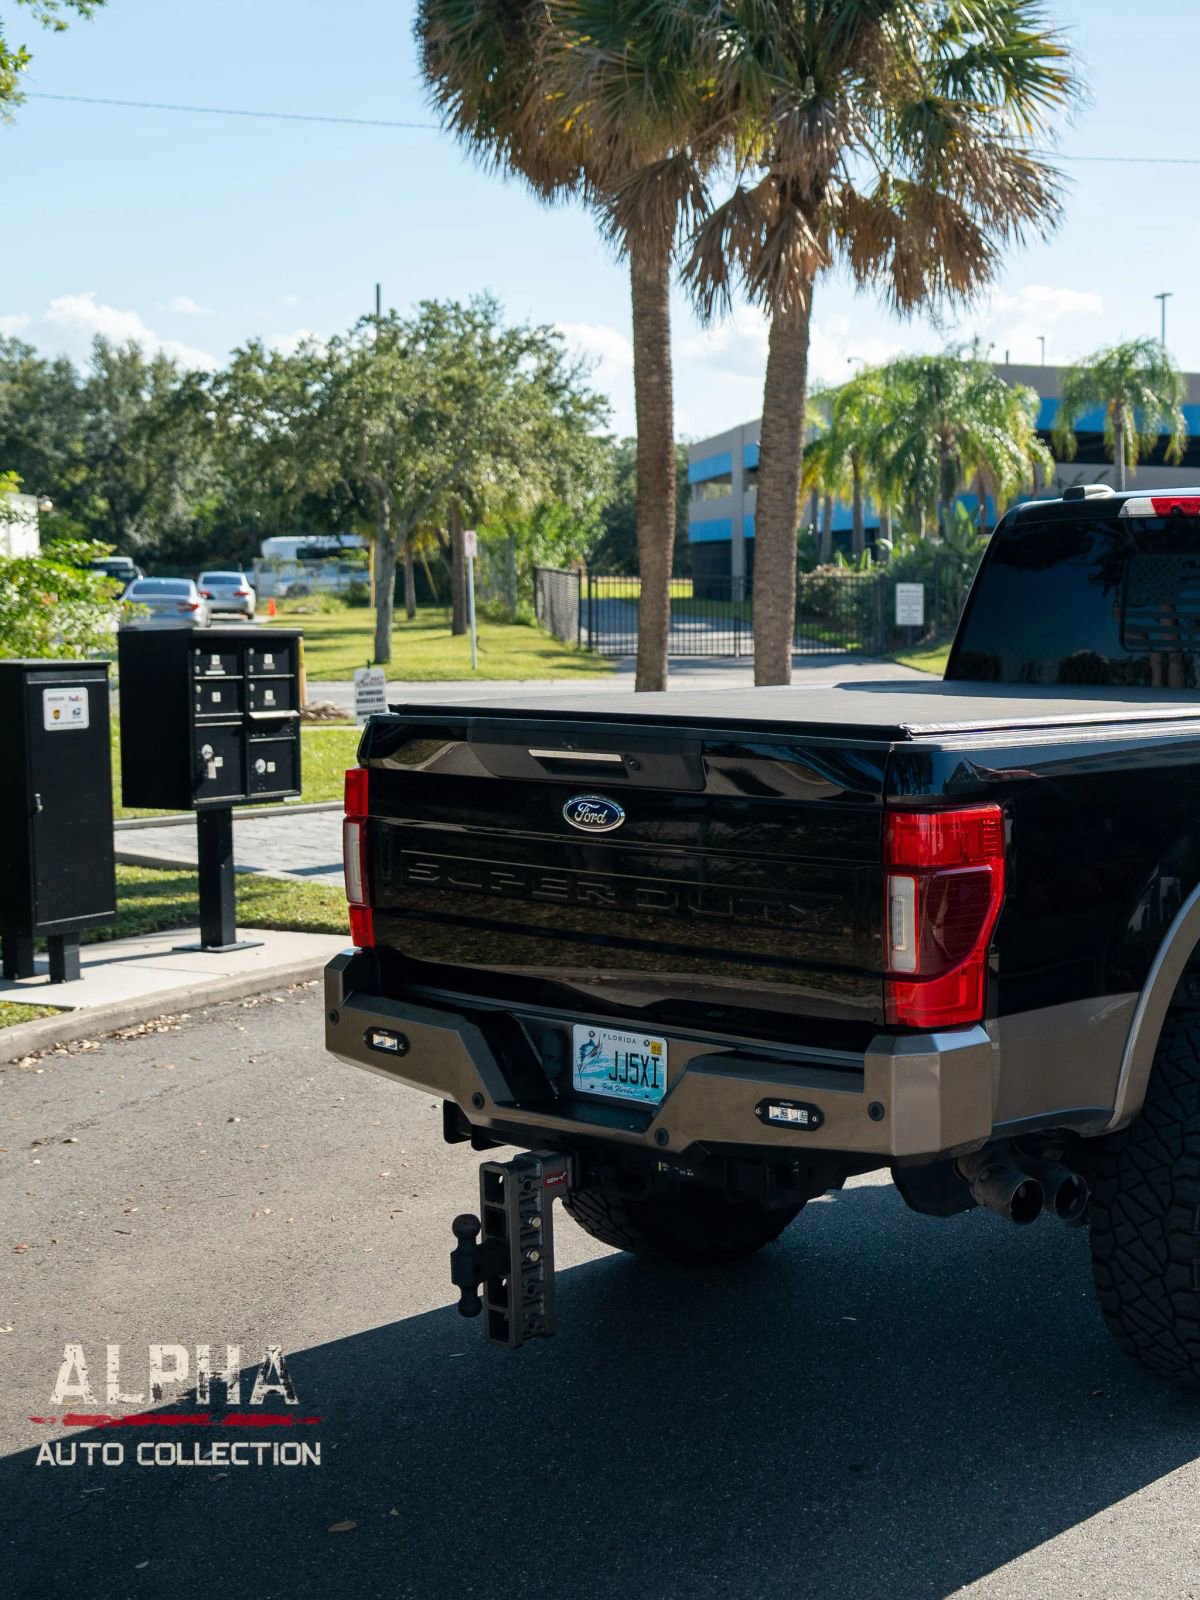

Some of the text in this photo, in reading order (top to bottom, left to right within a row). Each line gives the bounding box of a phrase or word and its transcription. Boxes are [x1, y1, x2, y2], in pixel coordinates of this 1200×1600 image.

[574, 802, 608, 825] Ford
[407, 862, 836, 926] SUPER DUTY
[602, 1033, 637, 1045] FLORIDA
[608, 1050, 661, 1089] JJ5XI
